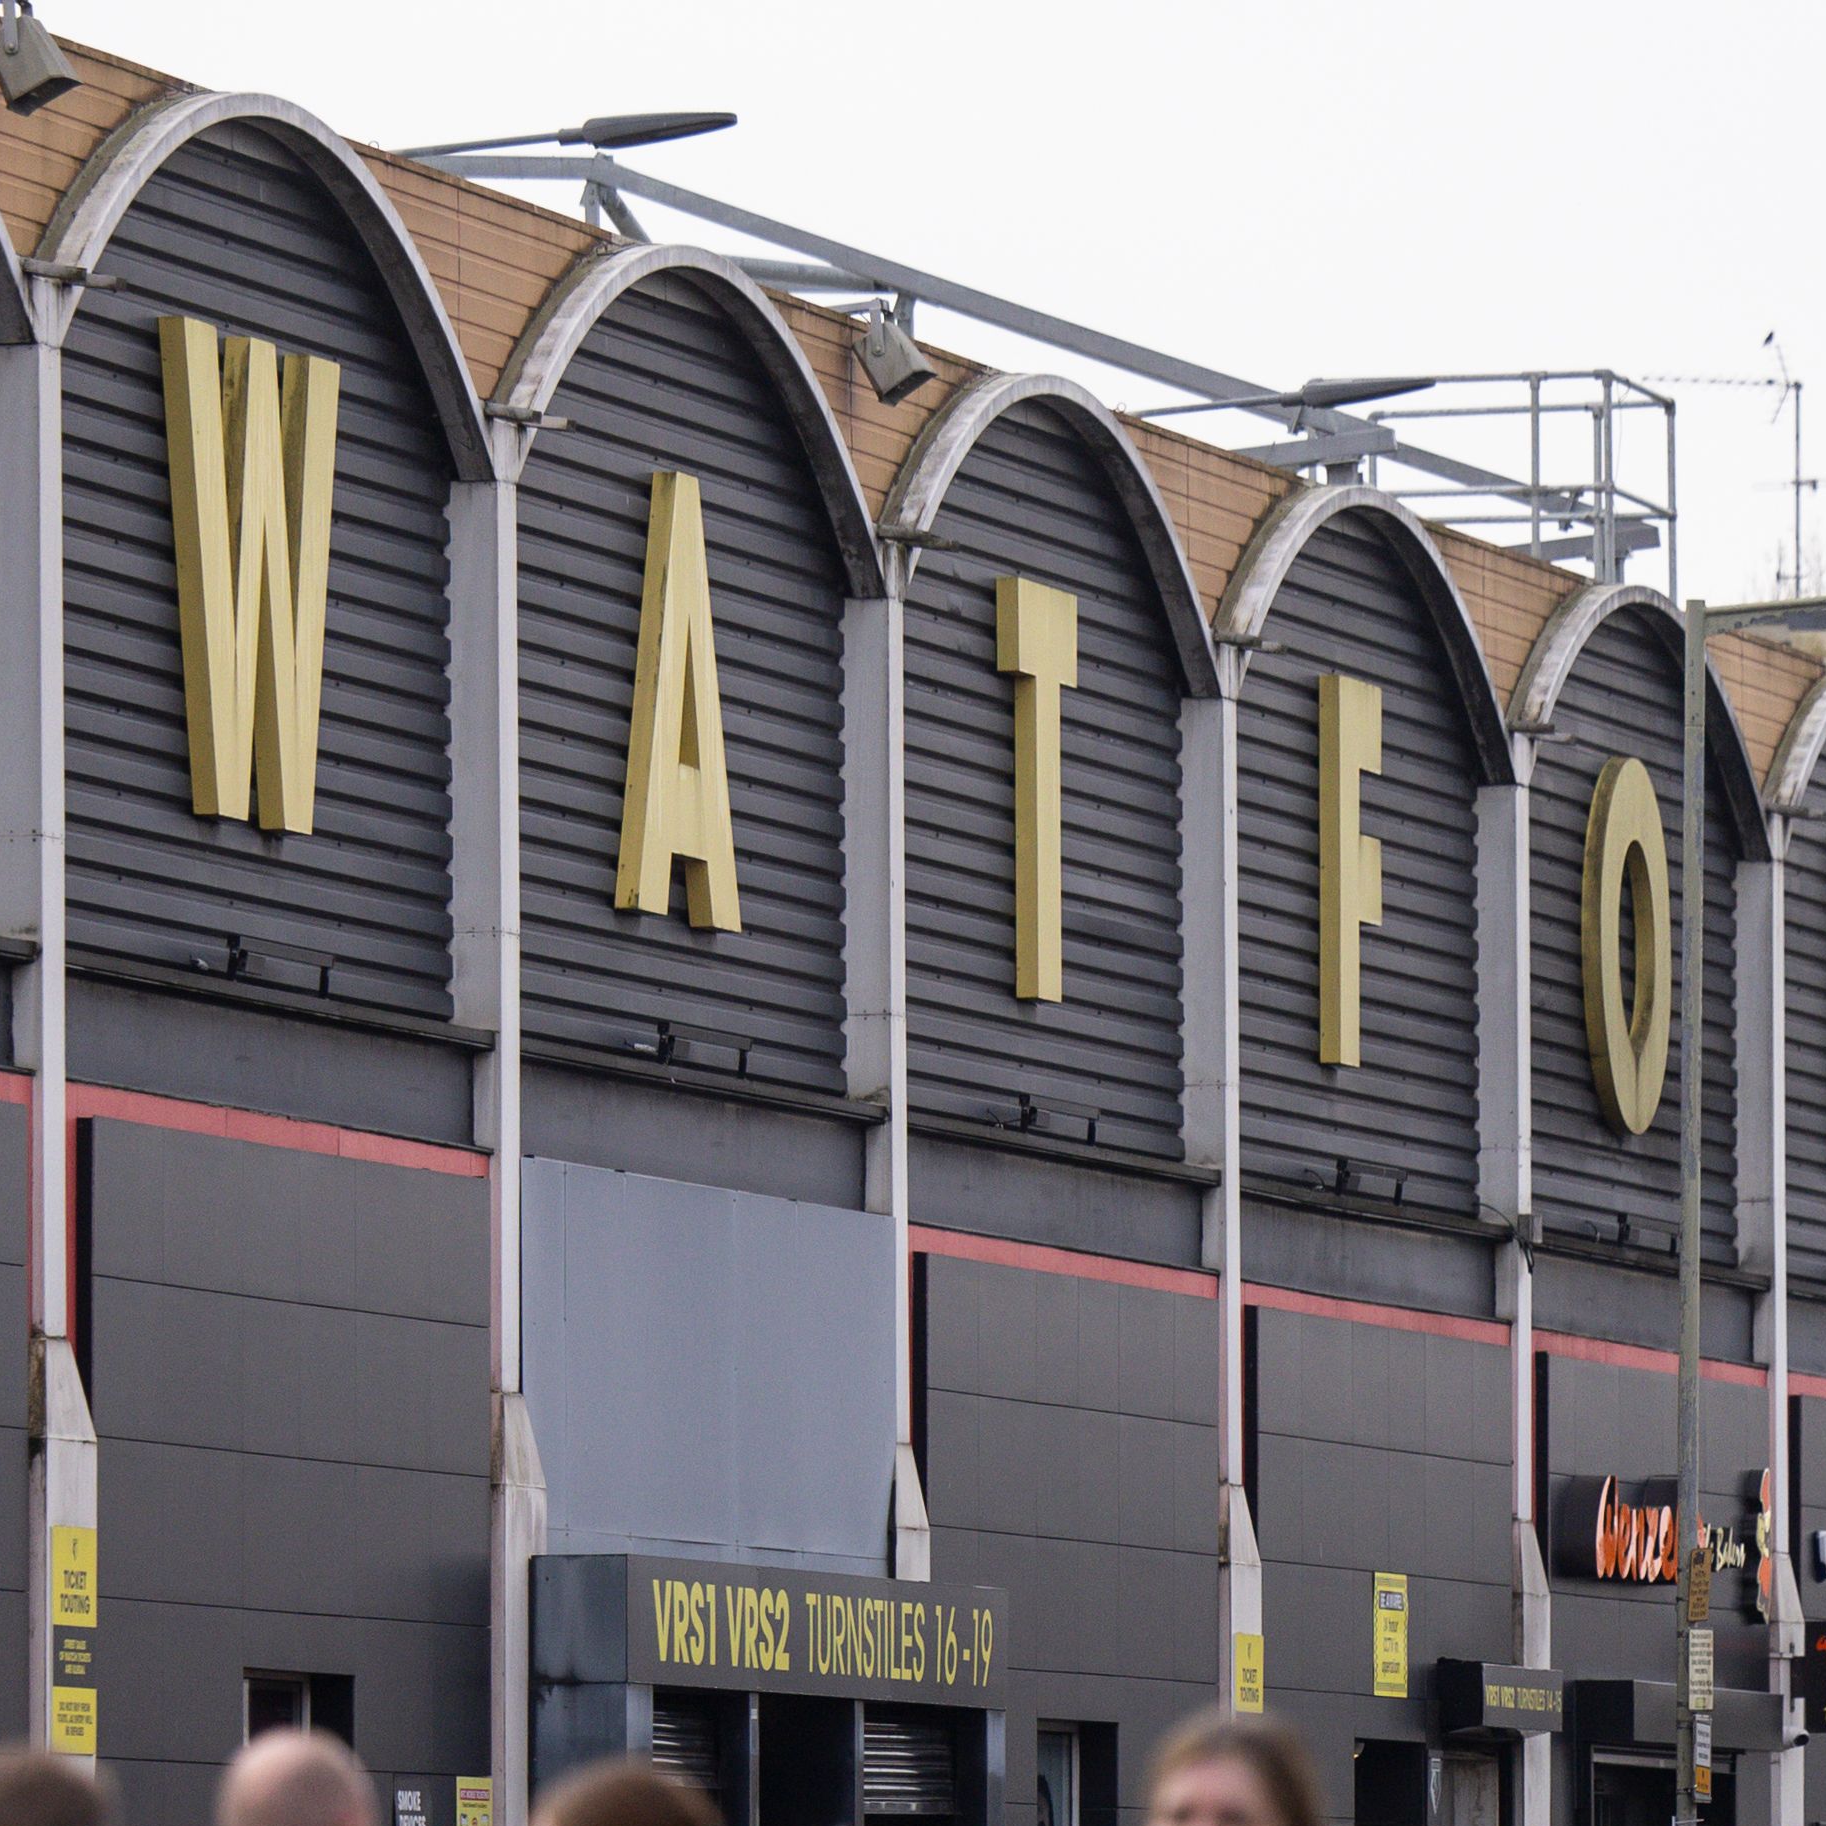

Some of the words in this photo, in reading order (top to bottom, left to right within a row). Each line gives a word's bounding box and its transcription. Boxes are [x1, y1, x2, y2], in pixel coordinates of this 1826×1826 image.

[63, 1570, 87, 1590] TICKET
[60, 1593, 90, 1614] TOUTING
[653, 1579, 716, 1666] VRS1
[726, 1585, 790, 1671] VRS2
[806, 1593, 925, 1683] TURNSTILES
[398, 1790, 421, 1811] SMOKE
